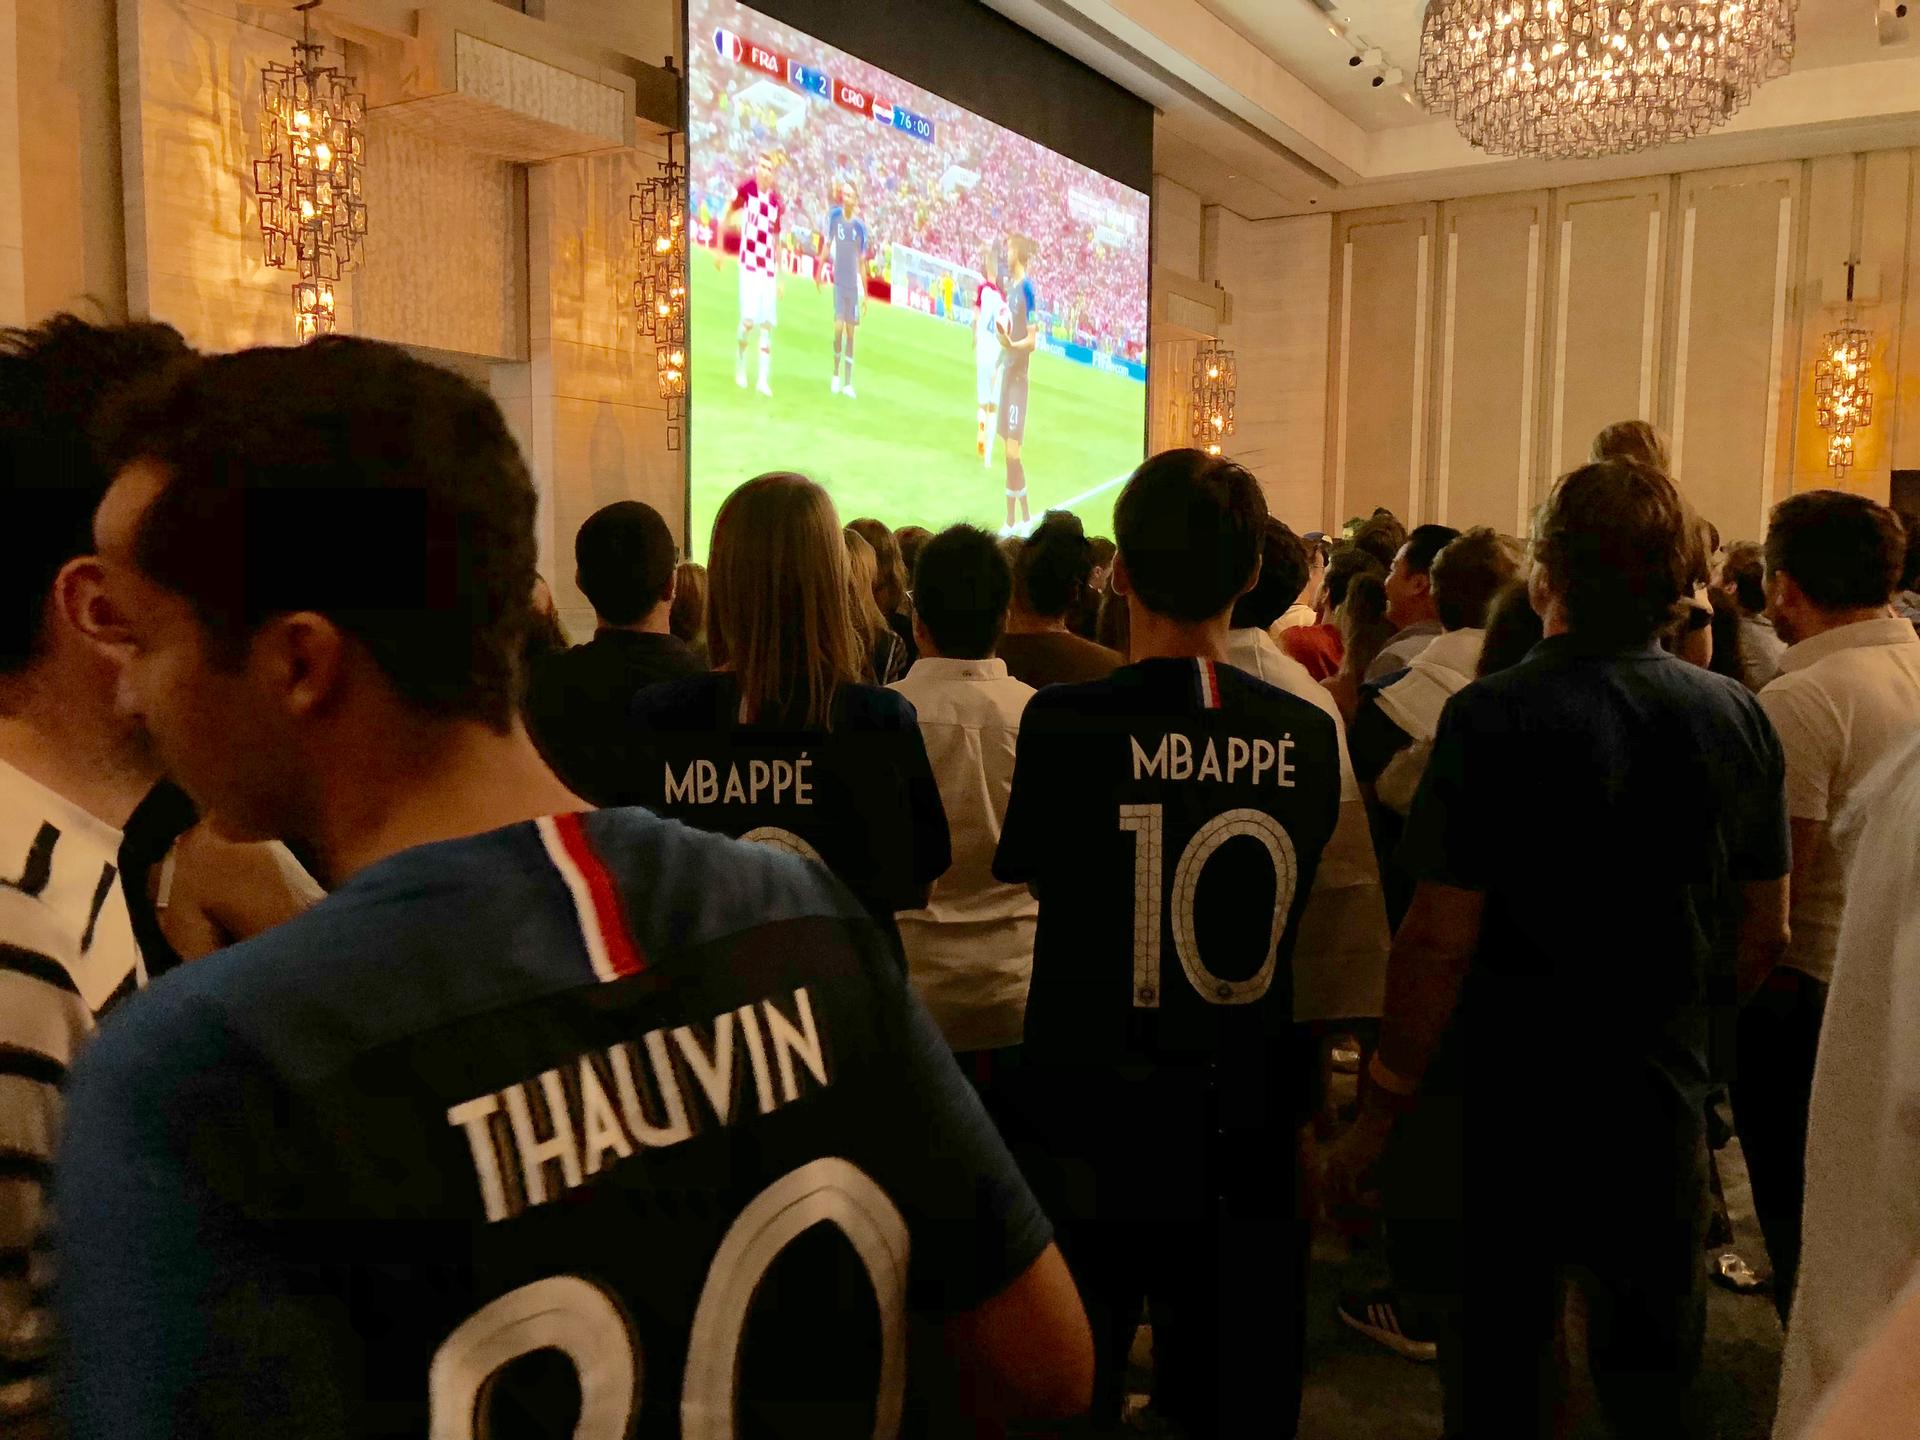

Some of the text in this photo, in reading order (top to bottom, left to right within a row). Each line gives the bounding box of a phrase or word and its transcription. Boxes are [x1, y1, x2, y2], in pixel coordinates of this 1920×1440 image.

[752, 46, 930, 137] FRA 4 2 CRO 76:00
[664, 753, 813, 805] MBAPPÉ
[1130, 732, 1296, 787] MBAPPÉ
[1119, 803, 1297, 1008] 10
[447, 987, 827, 1222] THAUVIN
